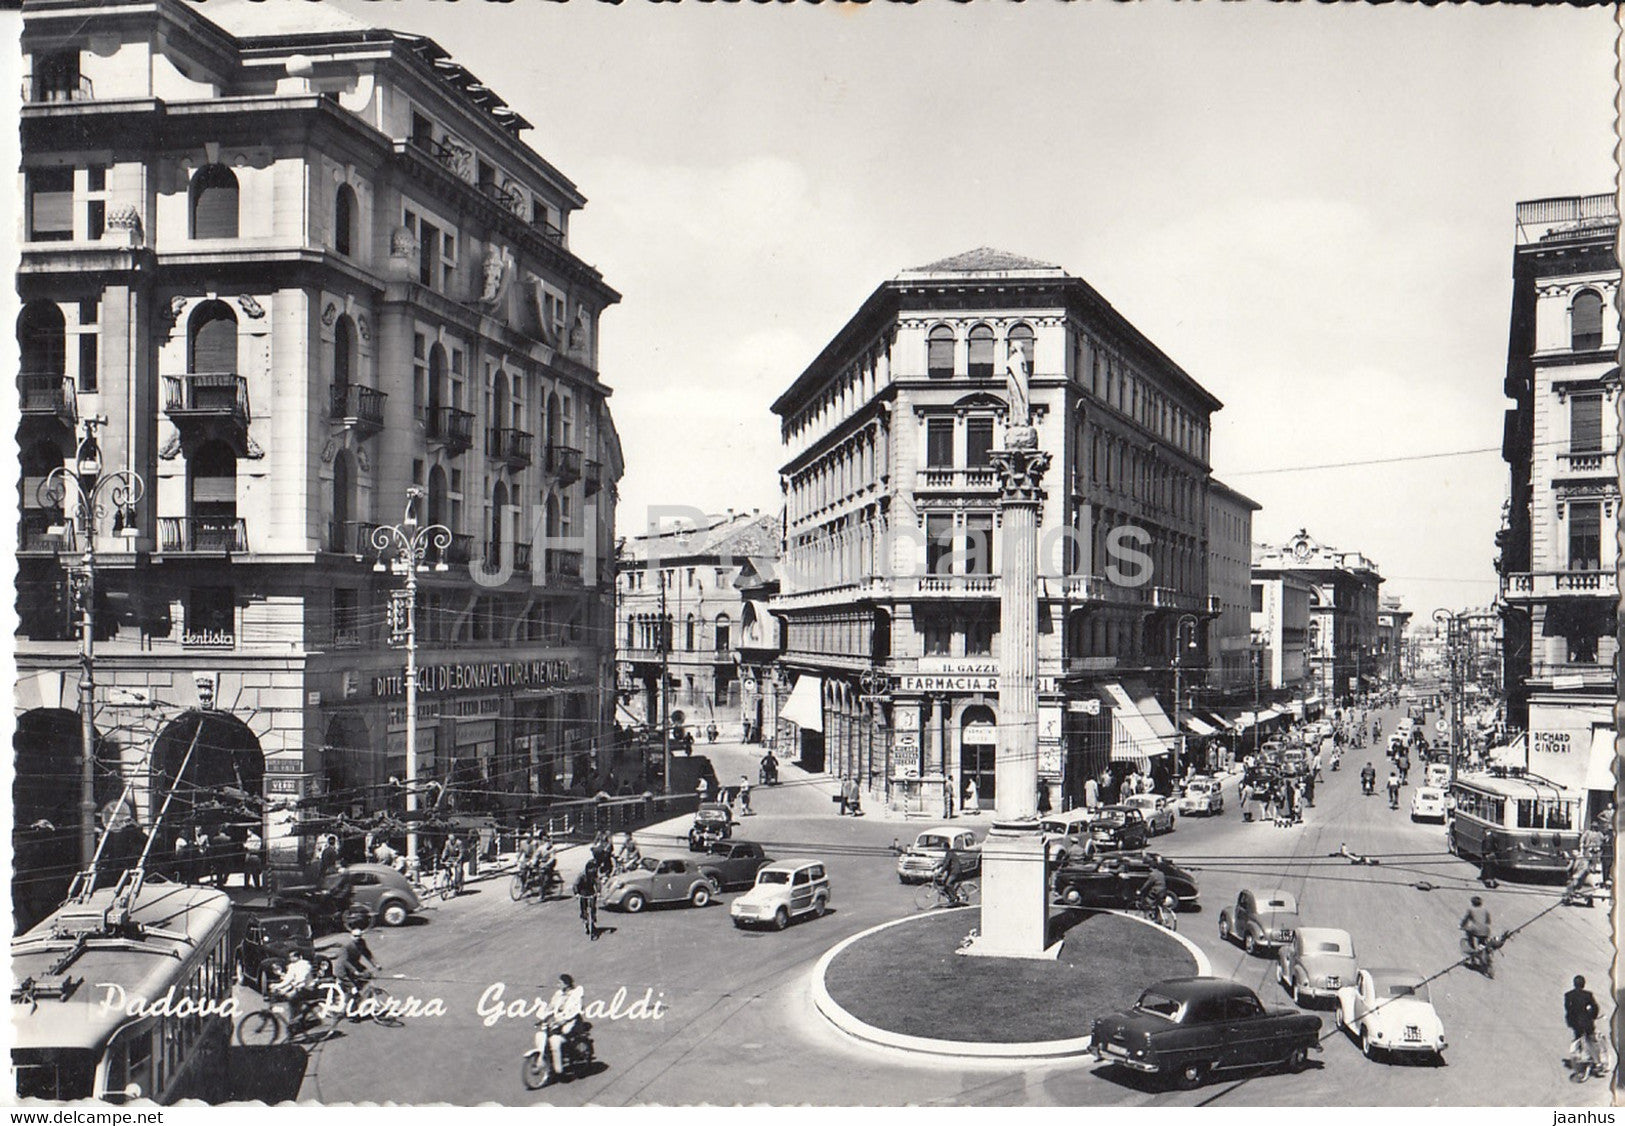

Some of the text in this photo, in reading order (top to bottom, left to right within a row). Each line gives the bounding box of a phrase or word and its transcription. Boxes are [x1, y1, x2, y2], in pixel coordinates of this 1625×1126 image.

[181, 628, 234, 645] dentista
[943, 664, 999, 672] IL GAZZE
[377, 676, 401, 696] DITTE
[456, 662, 529, 689] BONAVENTURA
[532, 660, 570, 683] MENATO
[907, 678, 981, 689] FARMACIA
[1534, 732, 1571, 742] RICHARD
[1534, 742, 1571, 753] GINORI
